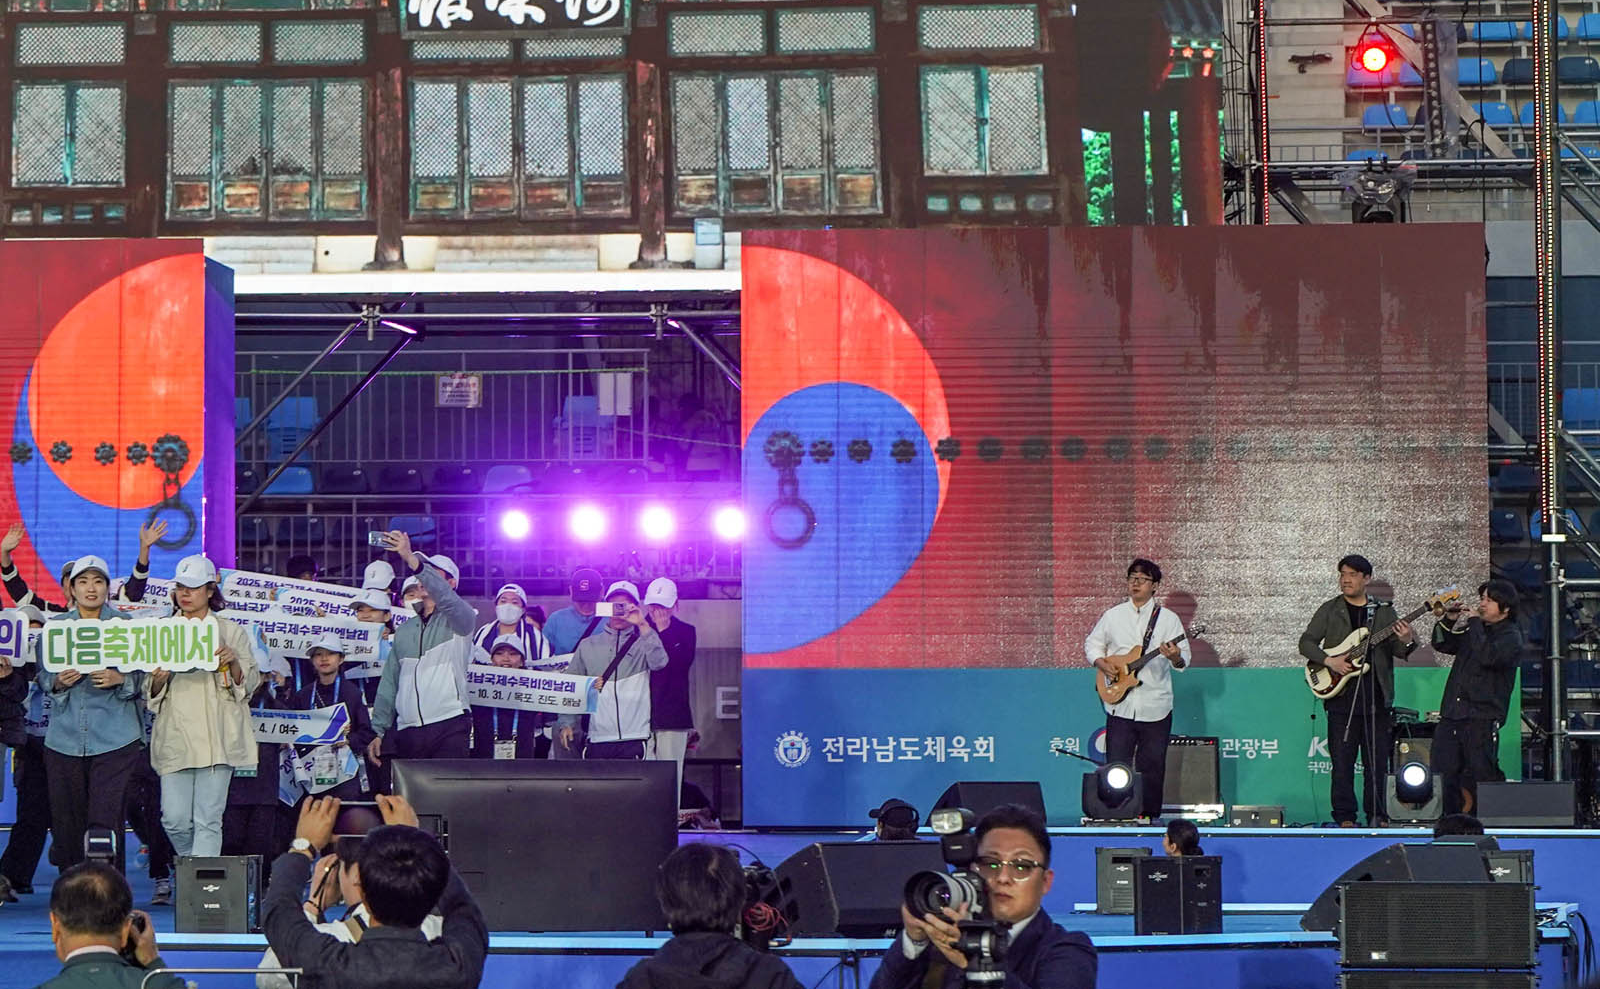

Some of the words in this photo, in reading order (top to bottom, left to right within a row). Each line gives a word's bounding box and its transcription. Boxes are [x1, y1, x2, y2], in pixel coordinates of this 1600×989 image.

[492, 690, 504, 700] 31.
[279, 723, 300, 735] 여수
[821, 736, 996, 763] 전라남도체육회
[1049, 737, 1080, 758] 후원
